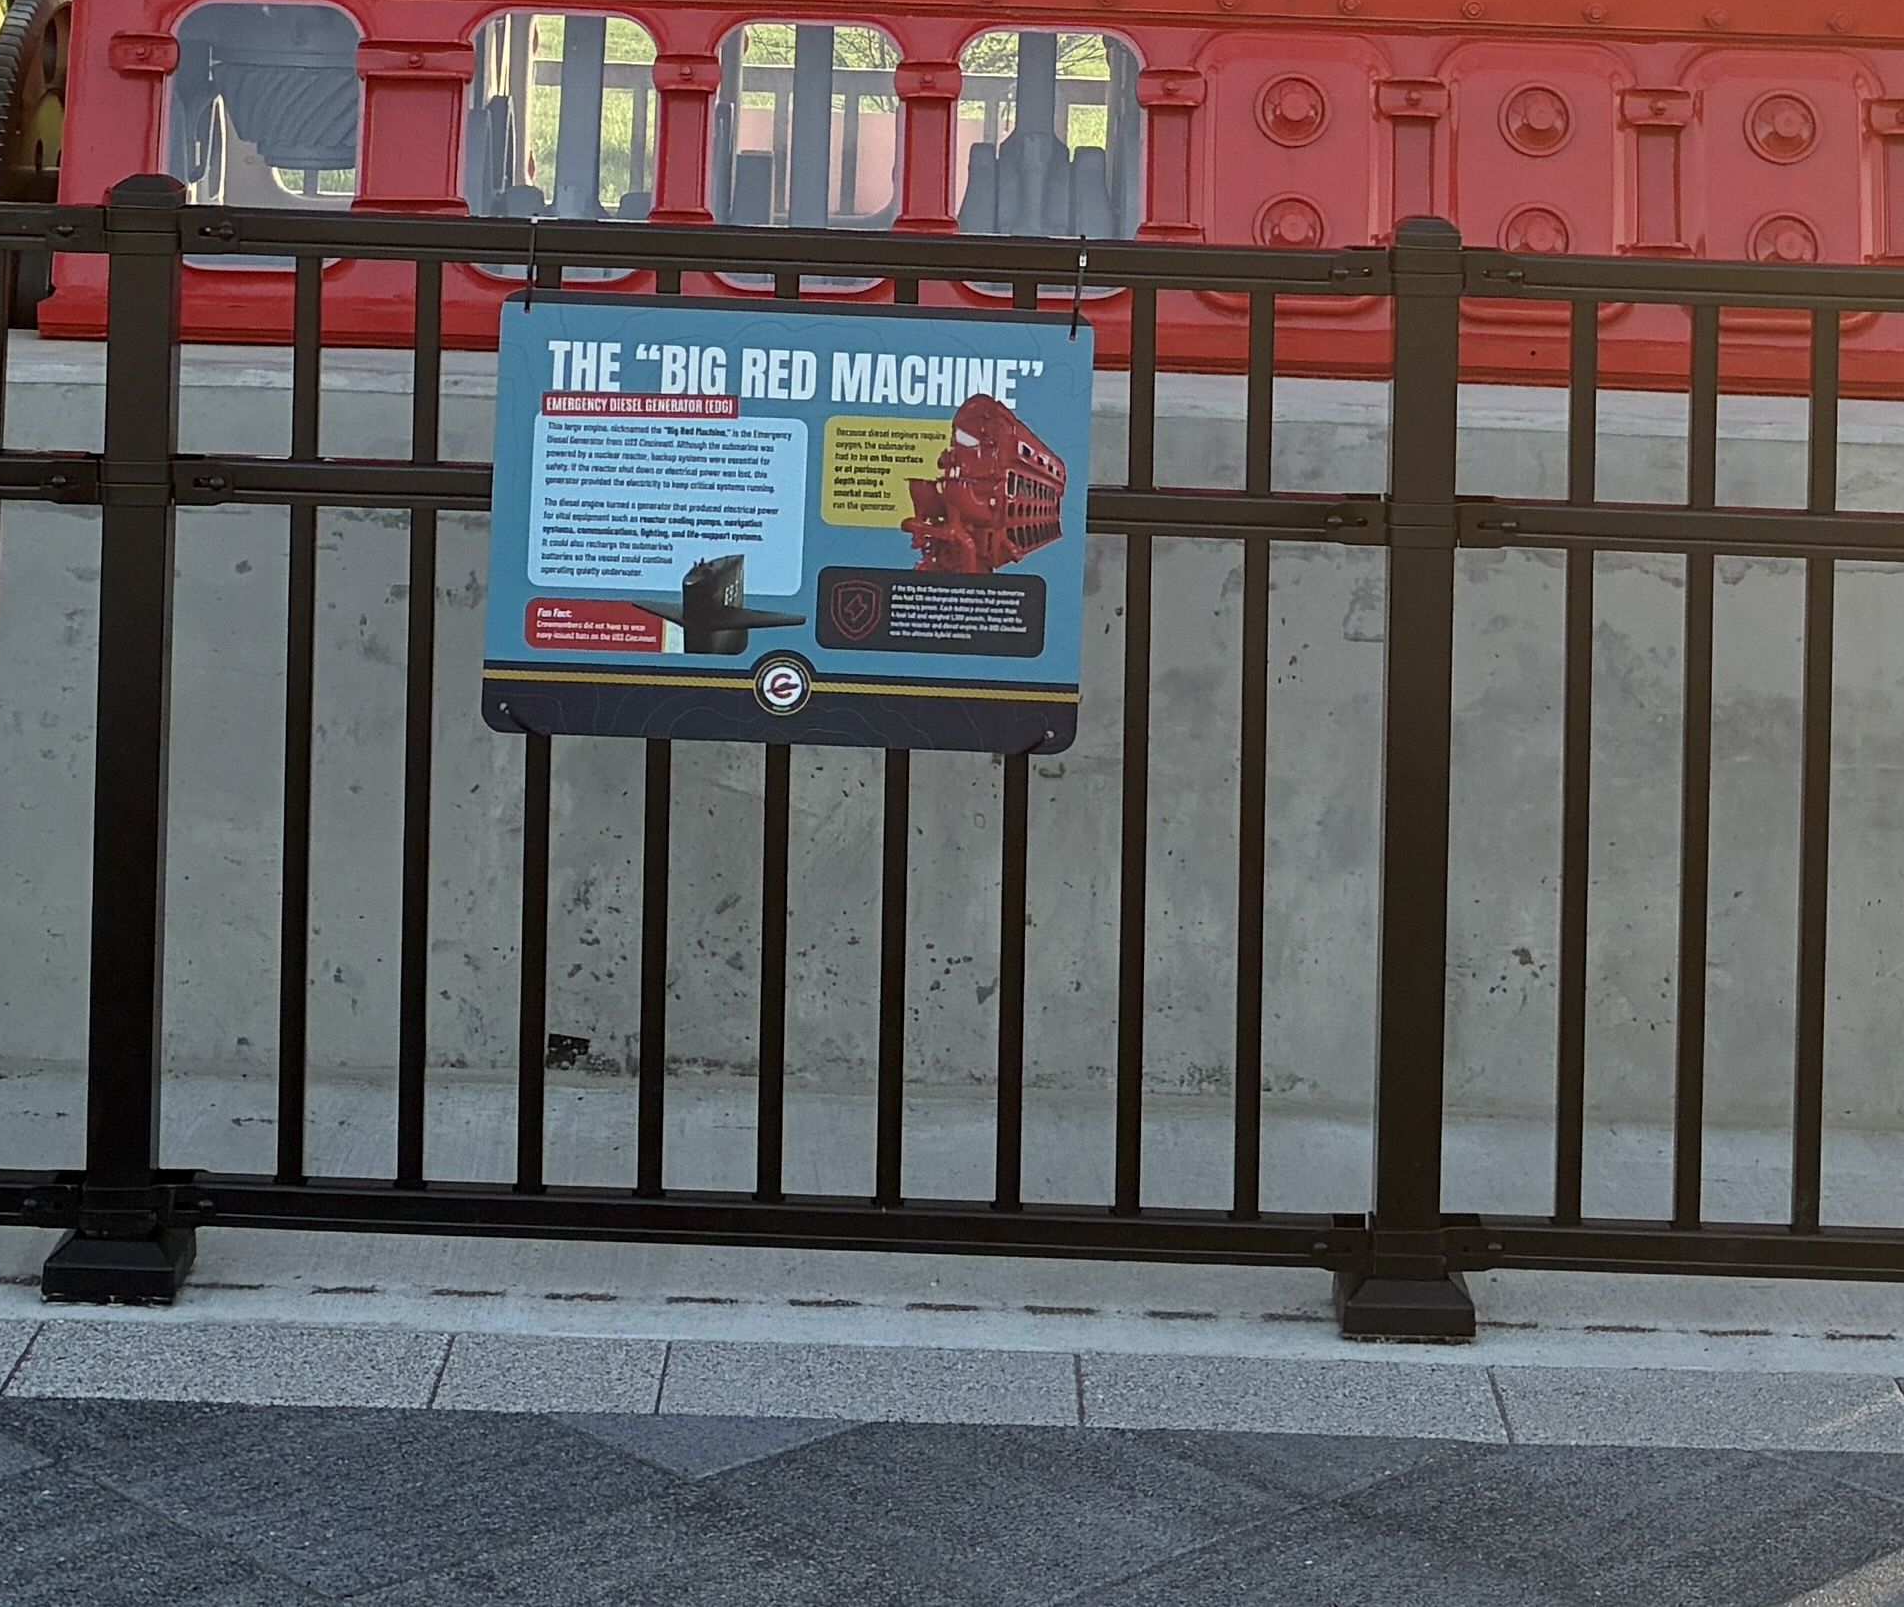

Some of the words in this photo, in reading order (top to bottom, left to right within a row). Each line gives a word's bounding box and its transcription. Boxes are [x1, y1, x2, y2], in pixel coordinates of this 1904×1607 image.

[547, 340, 621, 393] THE
[741, 349, 817, 400] RED
[546, 397, 609, 412] EMERGENCY
[610, 398, 644, 413] DIESEL
[645, 399, 703, 414] GENERATOR
[704, 400, 733, 415] (EDG)
